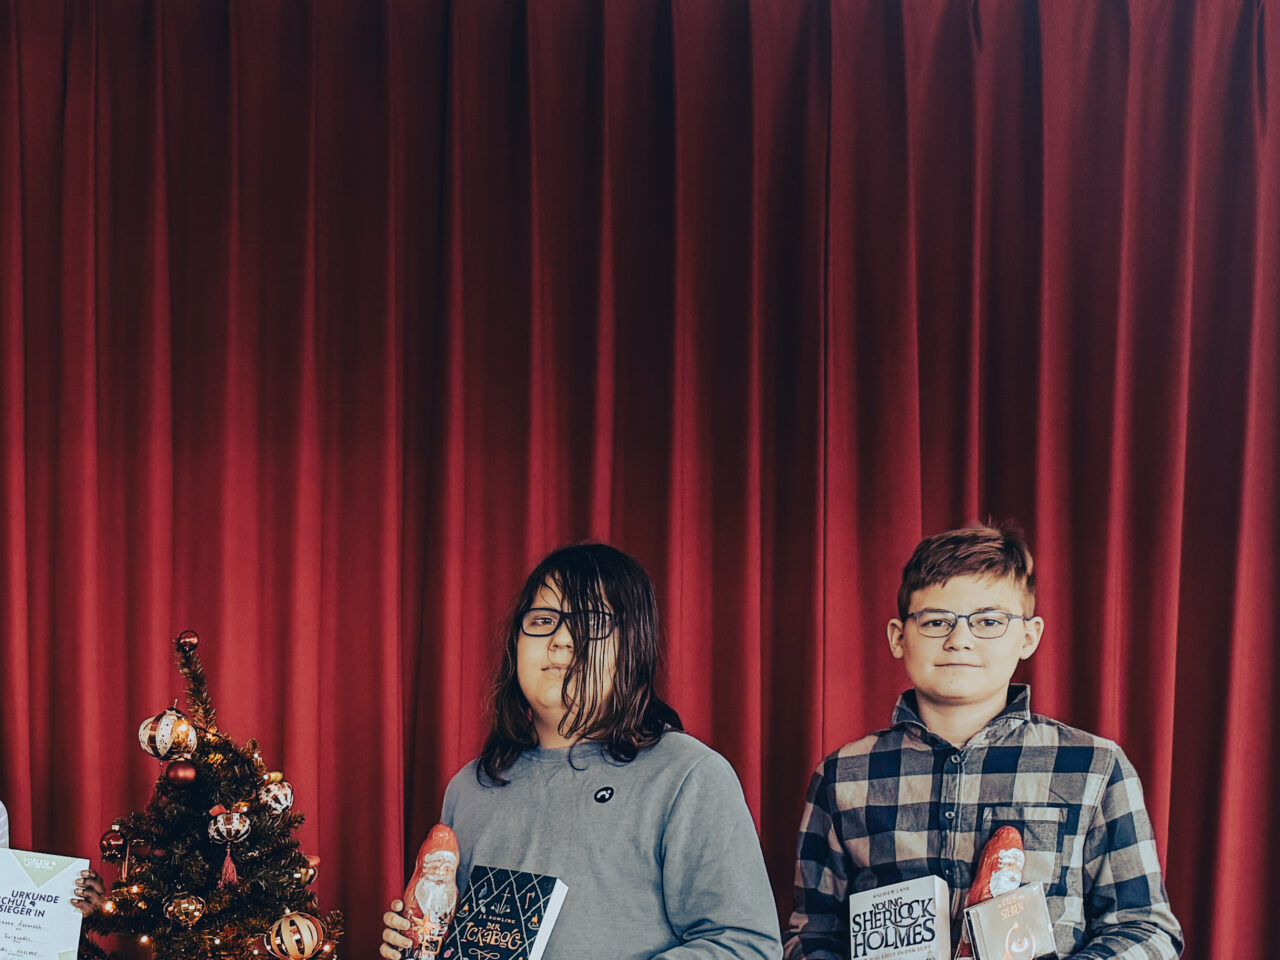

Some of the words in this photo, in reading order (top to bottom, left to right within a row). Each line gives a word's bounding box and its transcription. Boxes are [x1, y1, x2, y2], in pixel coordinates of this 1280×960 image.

[11, 890, 60, 904] URKUNDE
[872, 897, 903, 912] YOUNG
[488, 915, 516, 924] ROWLING
[852, 898, 936, 933] SHERLOCK
[486, 922, 501, 931] DER
[852, 918, 936, 958] HOLMES
